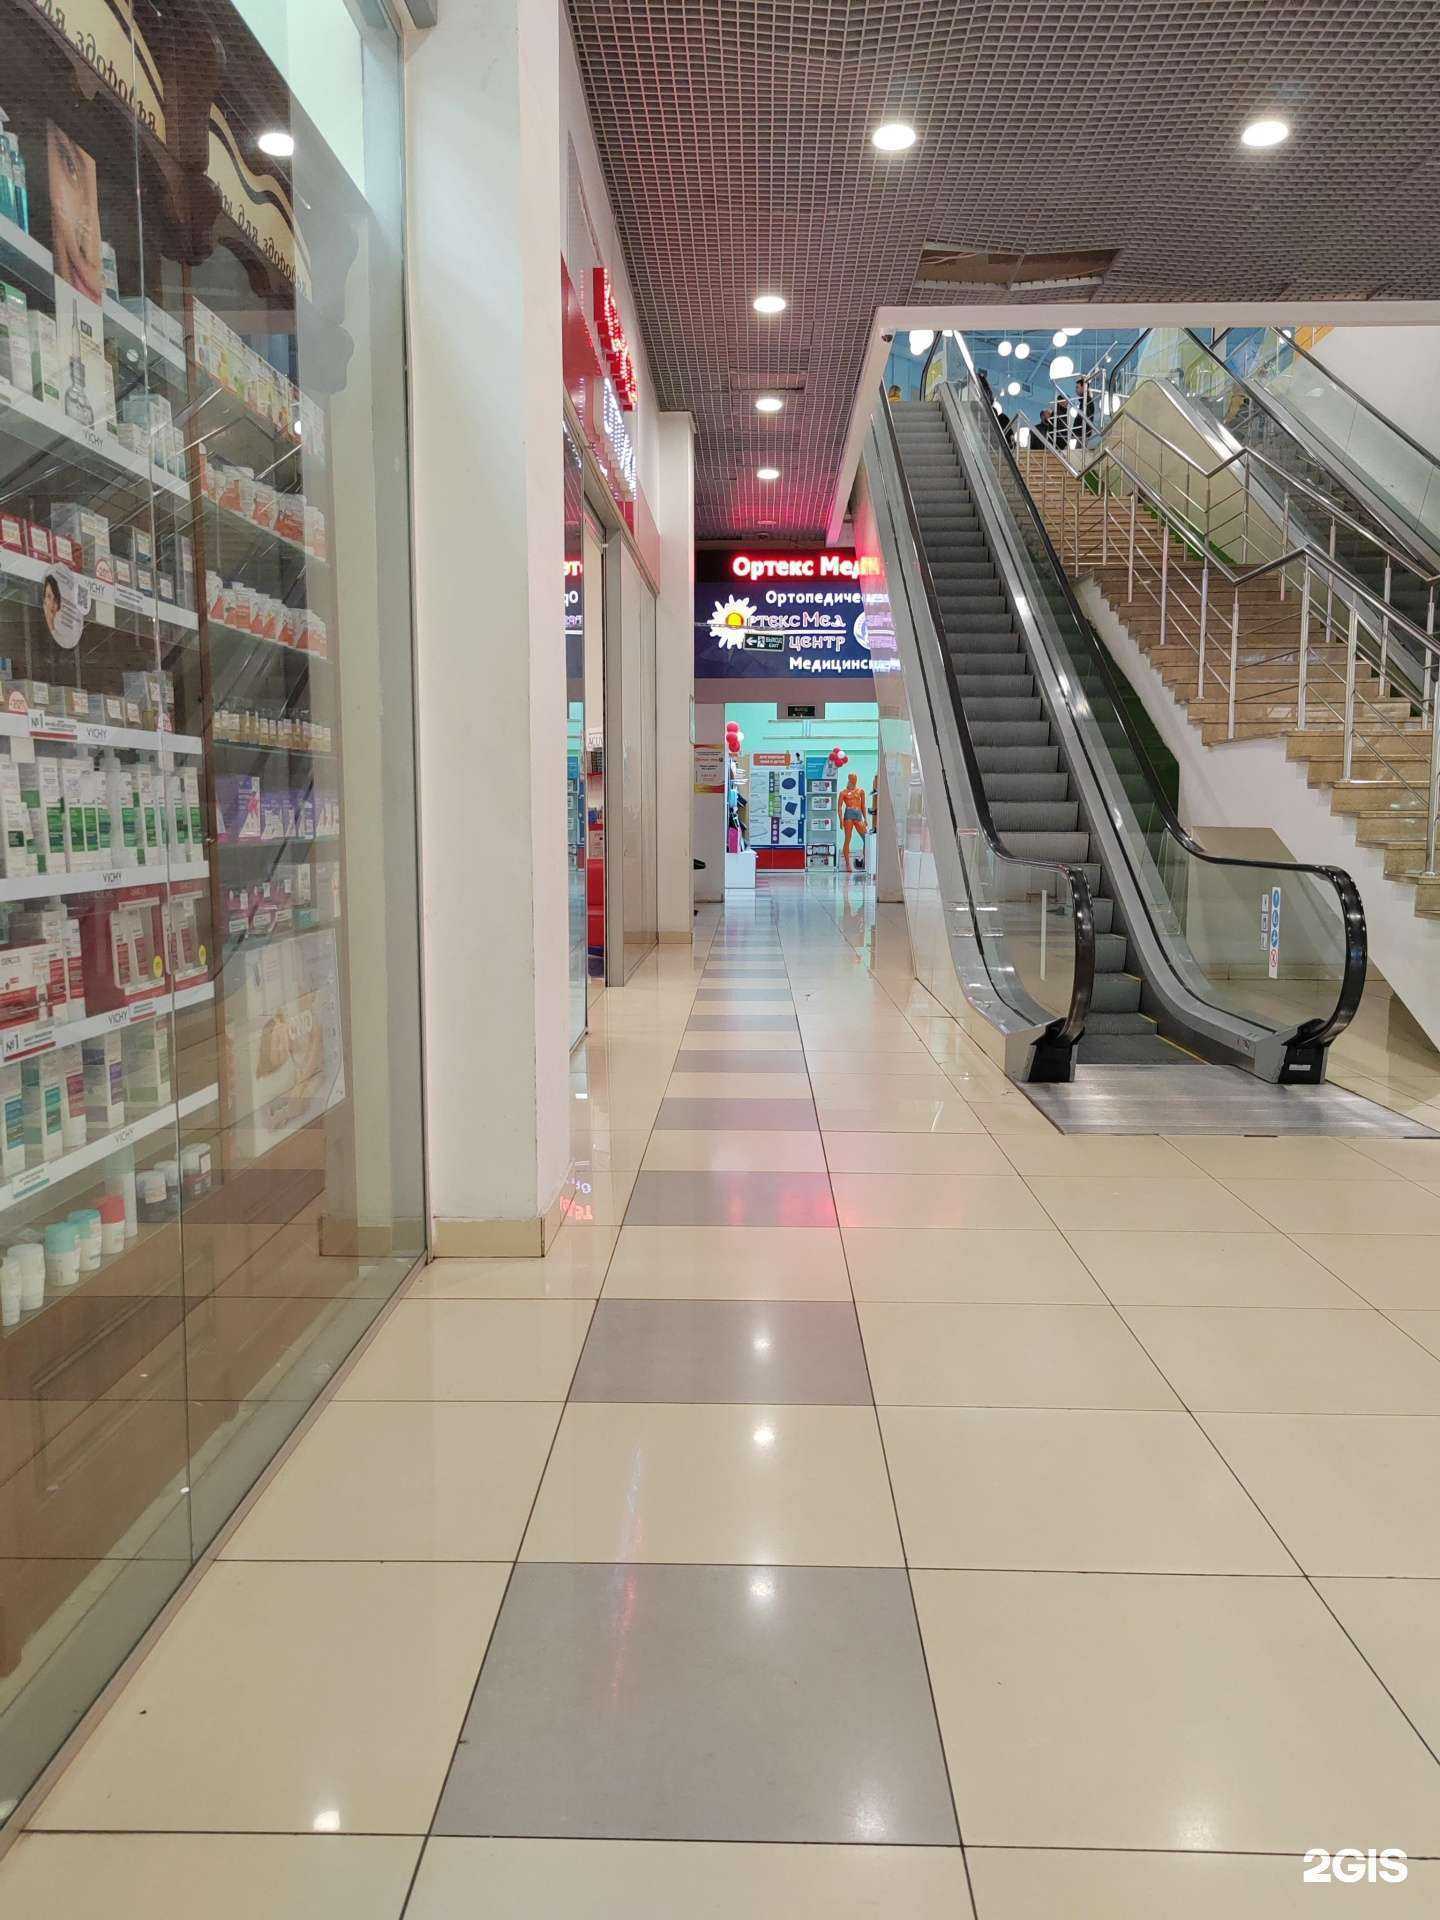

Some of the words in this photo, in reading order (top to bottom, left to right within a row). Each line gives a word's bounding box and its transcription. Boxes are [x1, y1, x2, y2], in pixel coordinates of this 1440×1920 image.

[263, 236, 304, 288] здоров
[732, 556, 814, 580] Ортекс
[765, 590, 886, 606] Ортопедиче
[789, 656, 899, 673] Медицинс
[86, 726, 109, 740] VICHY
[102, 872, 122, 884] VICHY
[108, 1010, 128, 1025] VICHY
